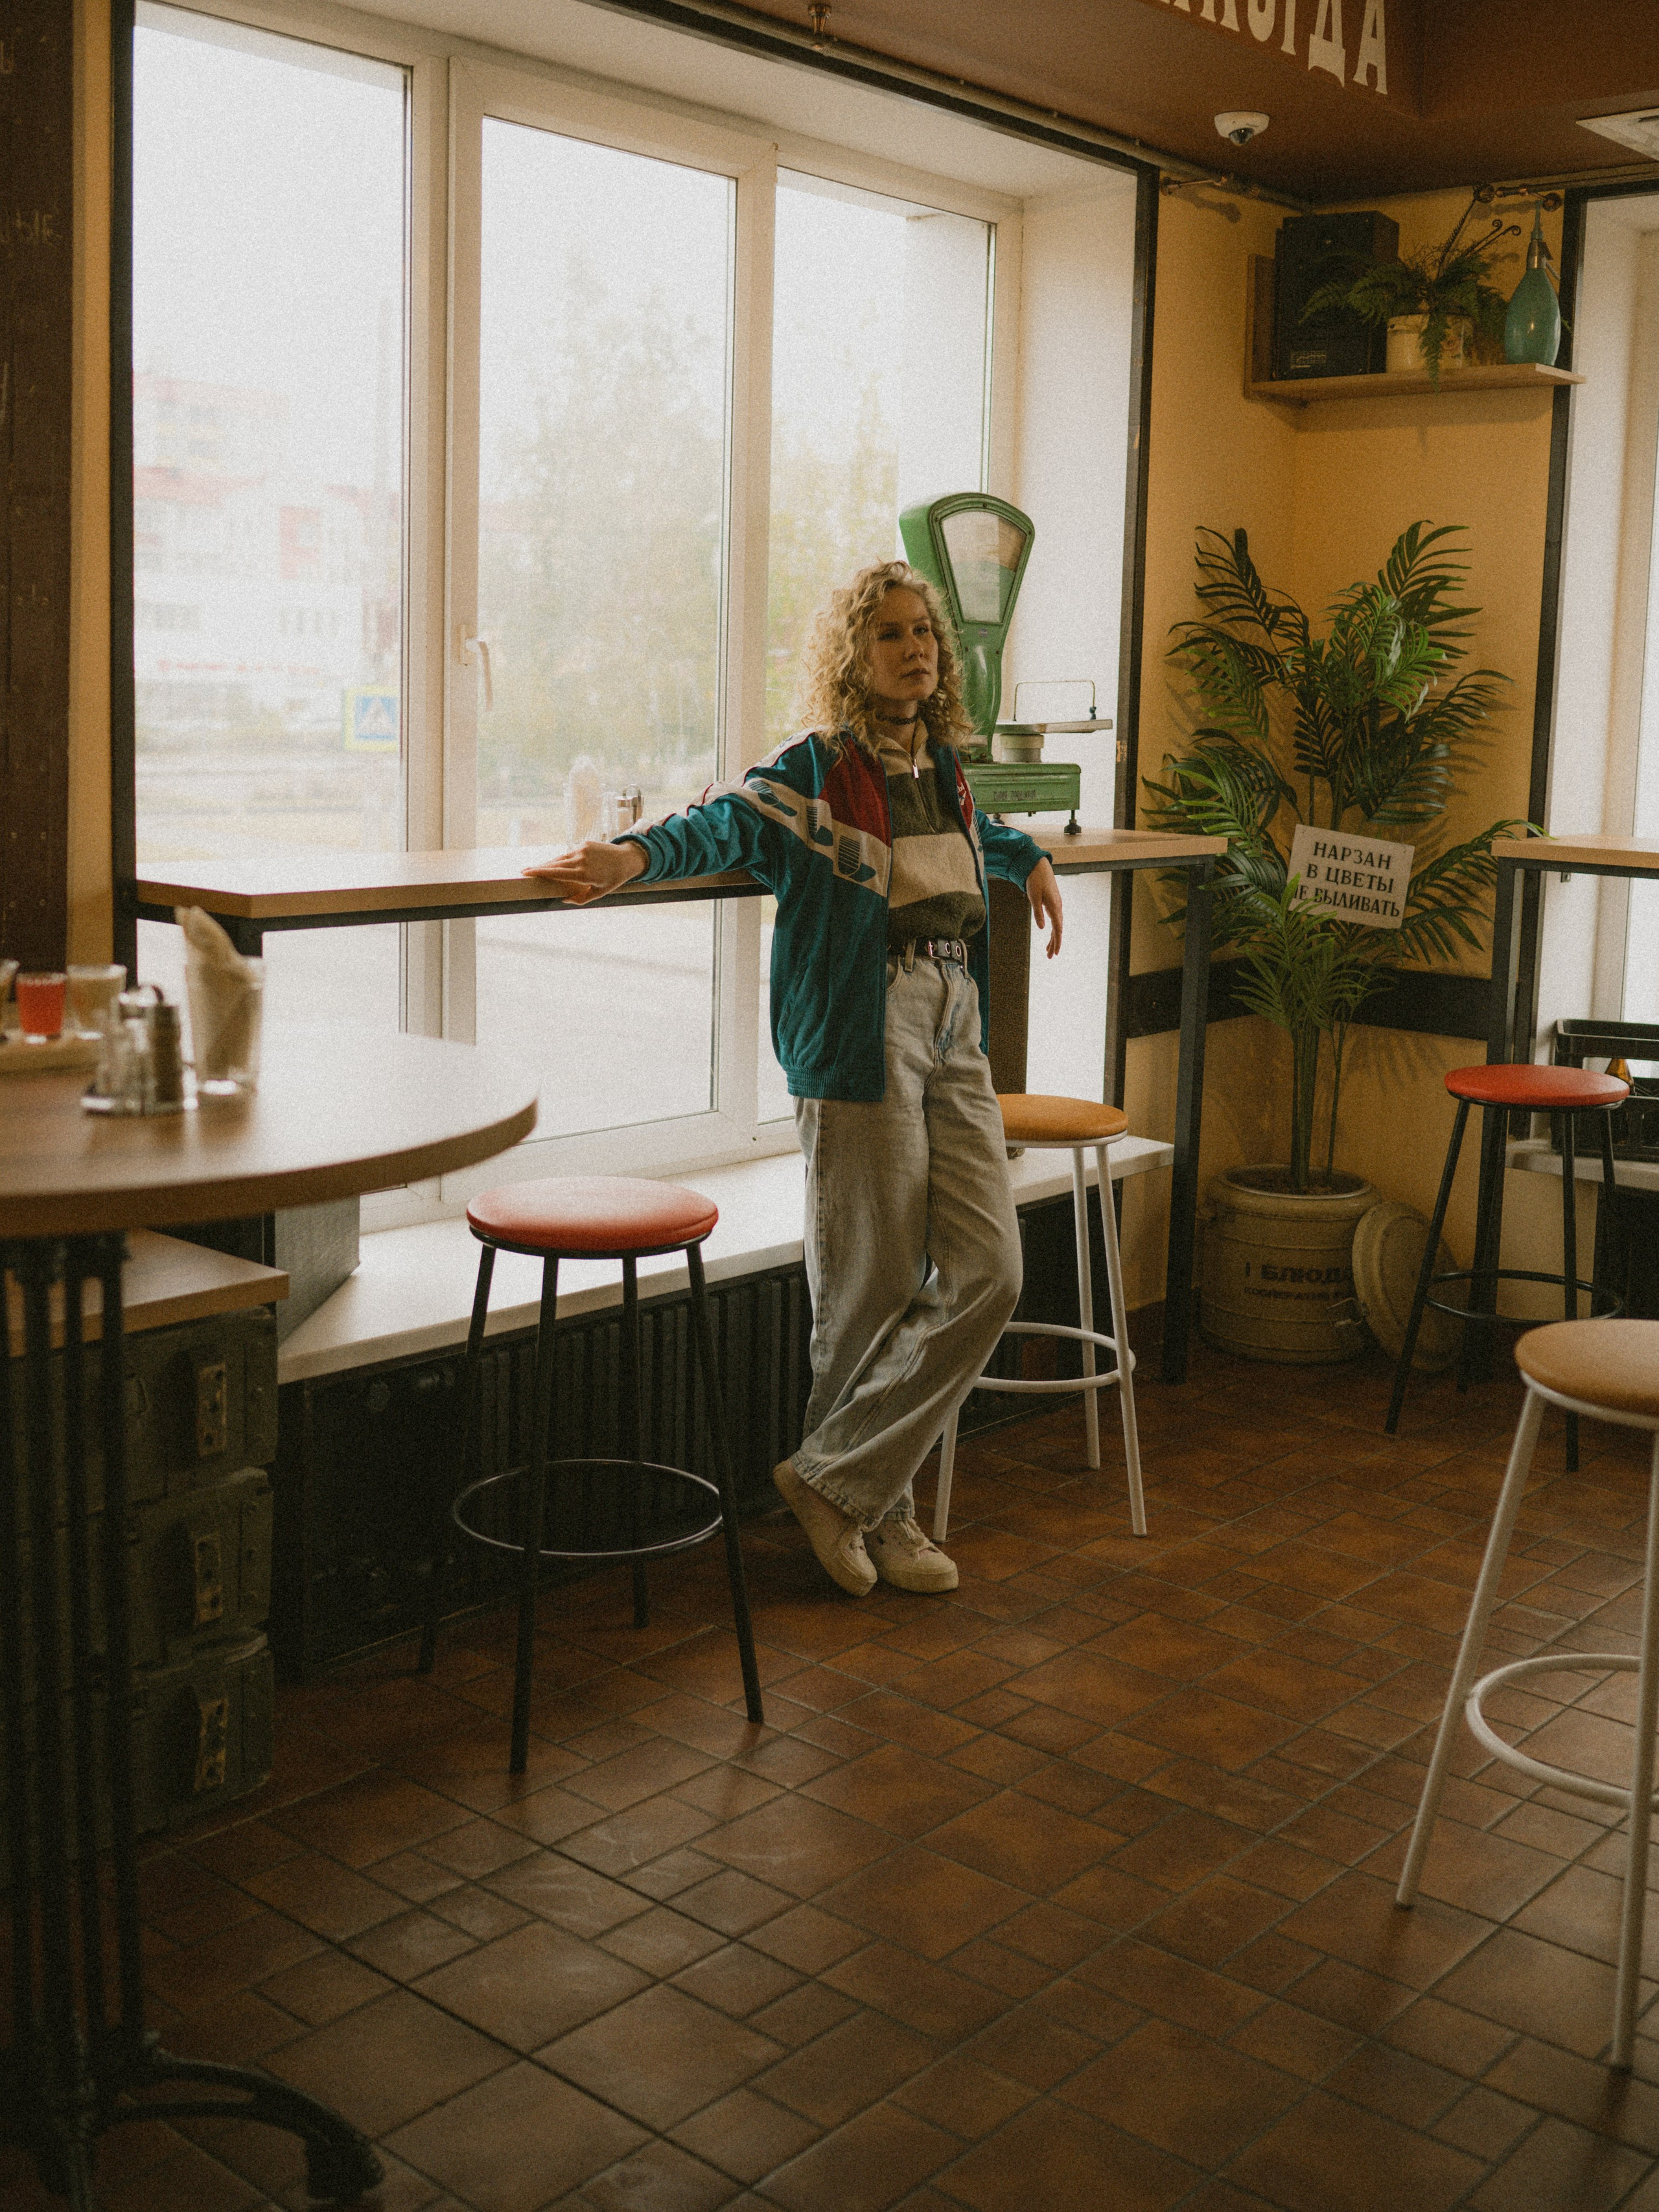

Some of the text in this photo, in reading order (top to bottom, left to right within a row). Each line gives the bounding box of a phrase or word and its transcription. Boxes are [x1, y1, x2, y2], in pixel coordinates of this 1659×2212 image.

[1313, 841, 1392, 870] НАРЗАН
[1306, 863, 1395, 894] В ЦВЕТЫ
[1313, 887, 1400, 918] ВЫЛИВАТЬ
